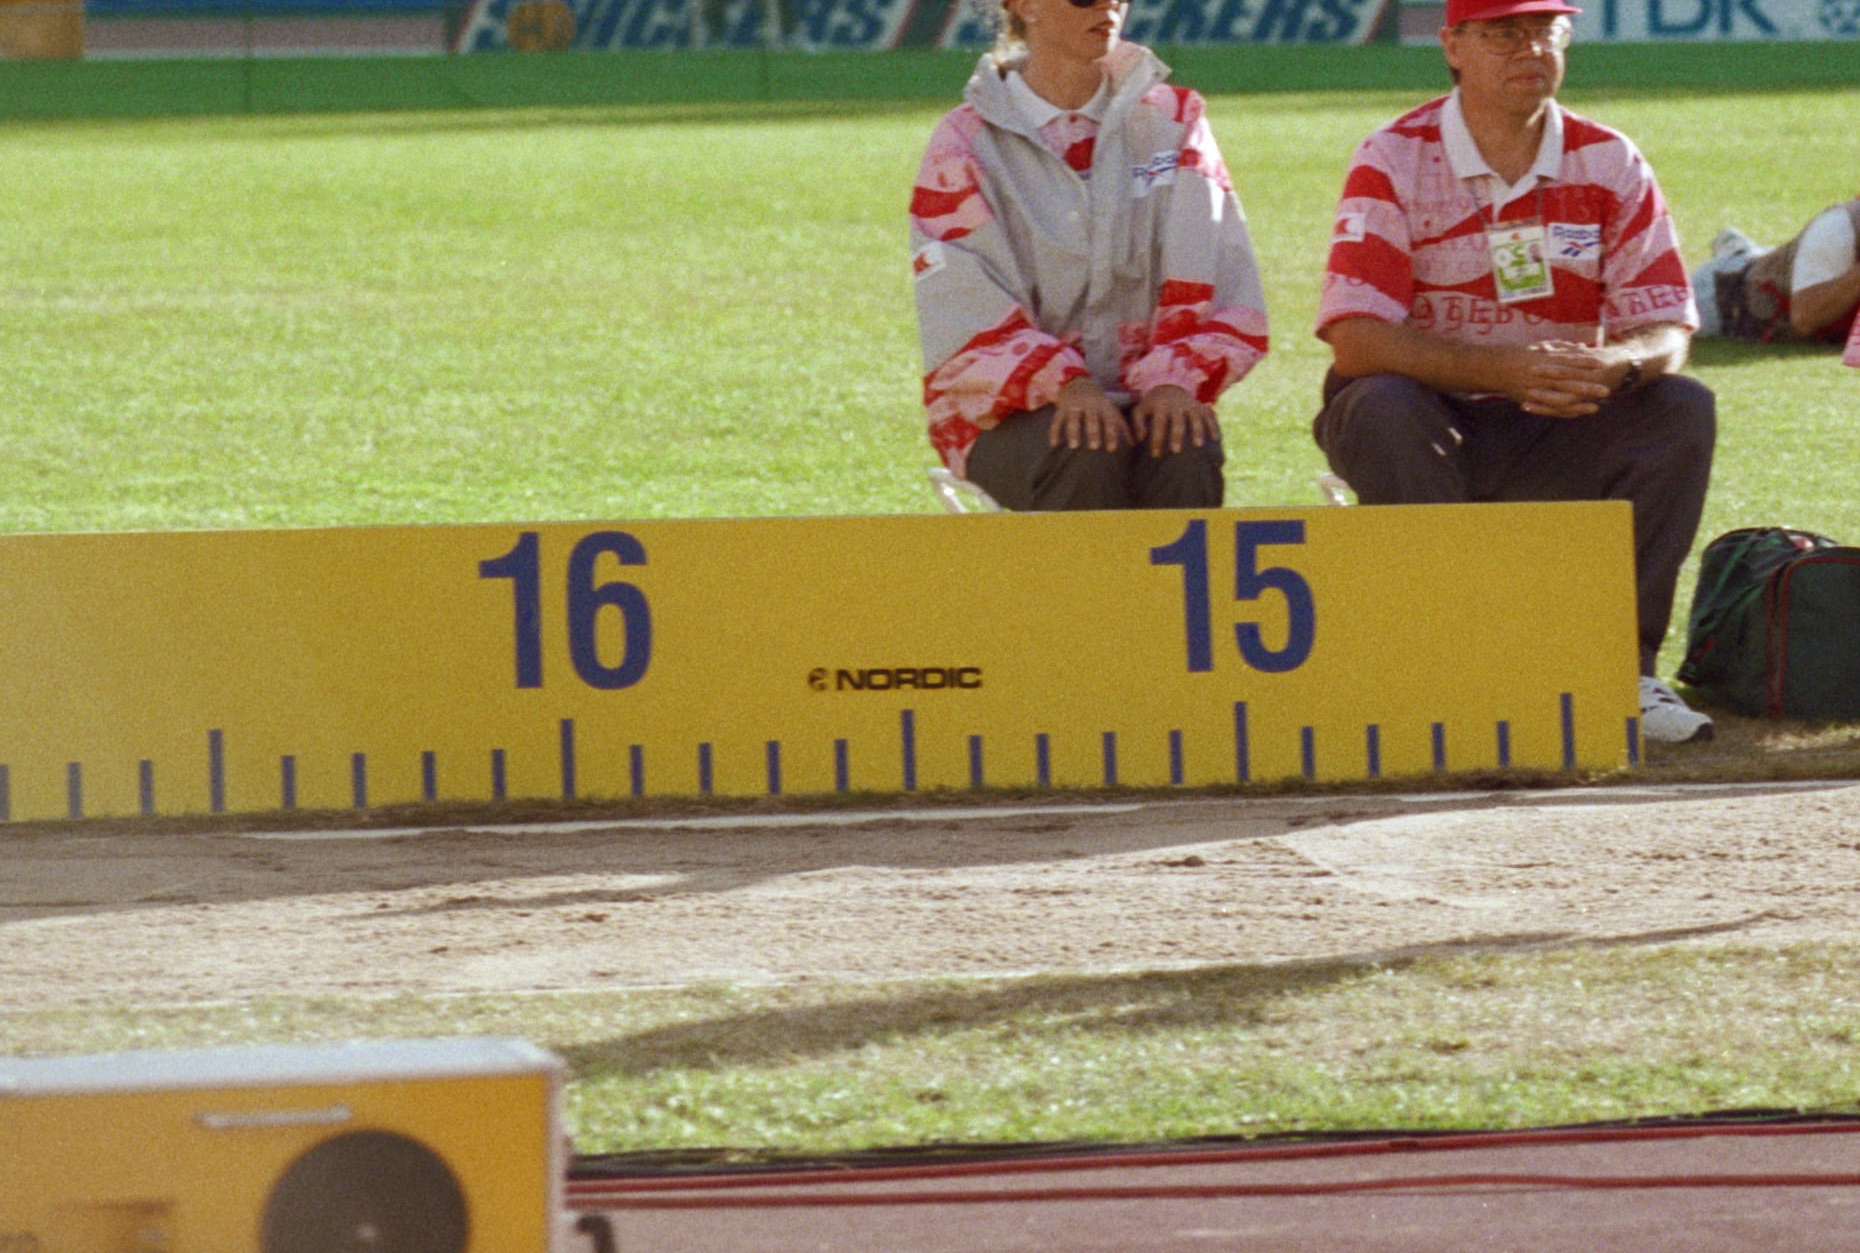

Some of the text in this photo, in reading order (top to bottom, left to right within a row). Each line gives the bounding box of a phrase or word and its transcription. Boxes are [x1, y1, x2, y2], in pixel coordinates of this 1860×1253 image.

[478, 531, 653, 690] 16
[1150, 519, 1315, 674] 15
[836, 667, 983, 691] NORDIC
